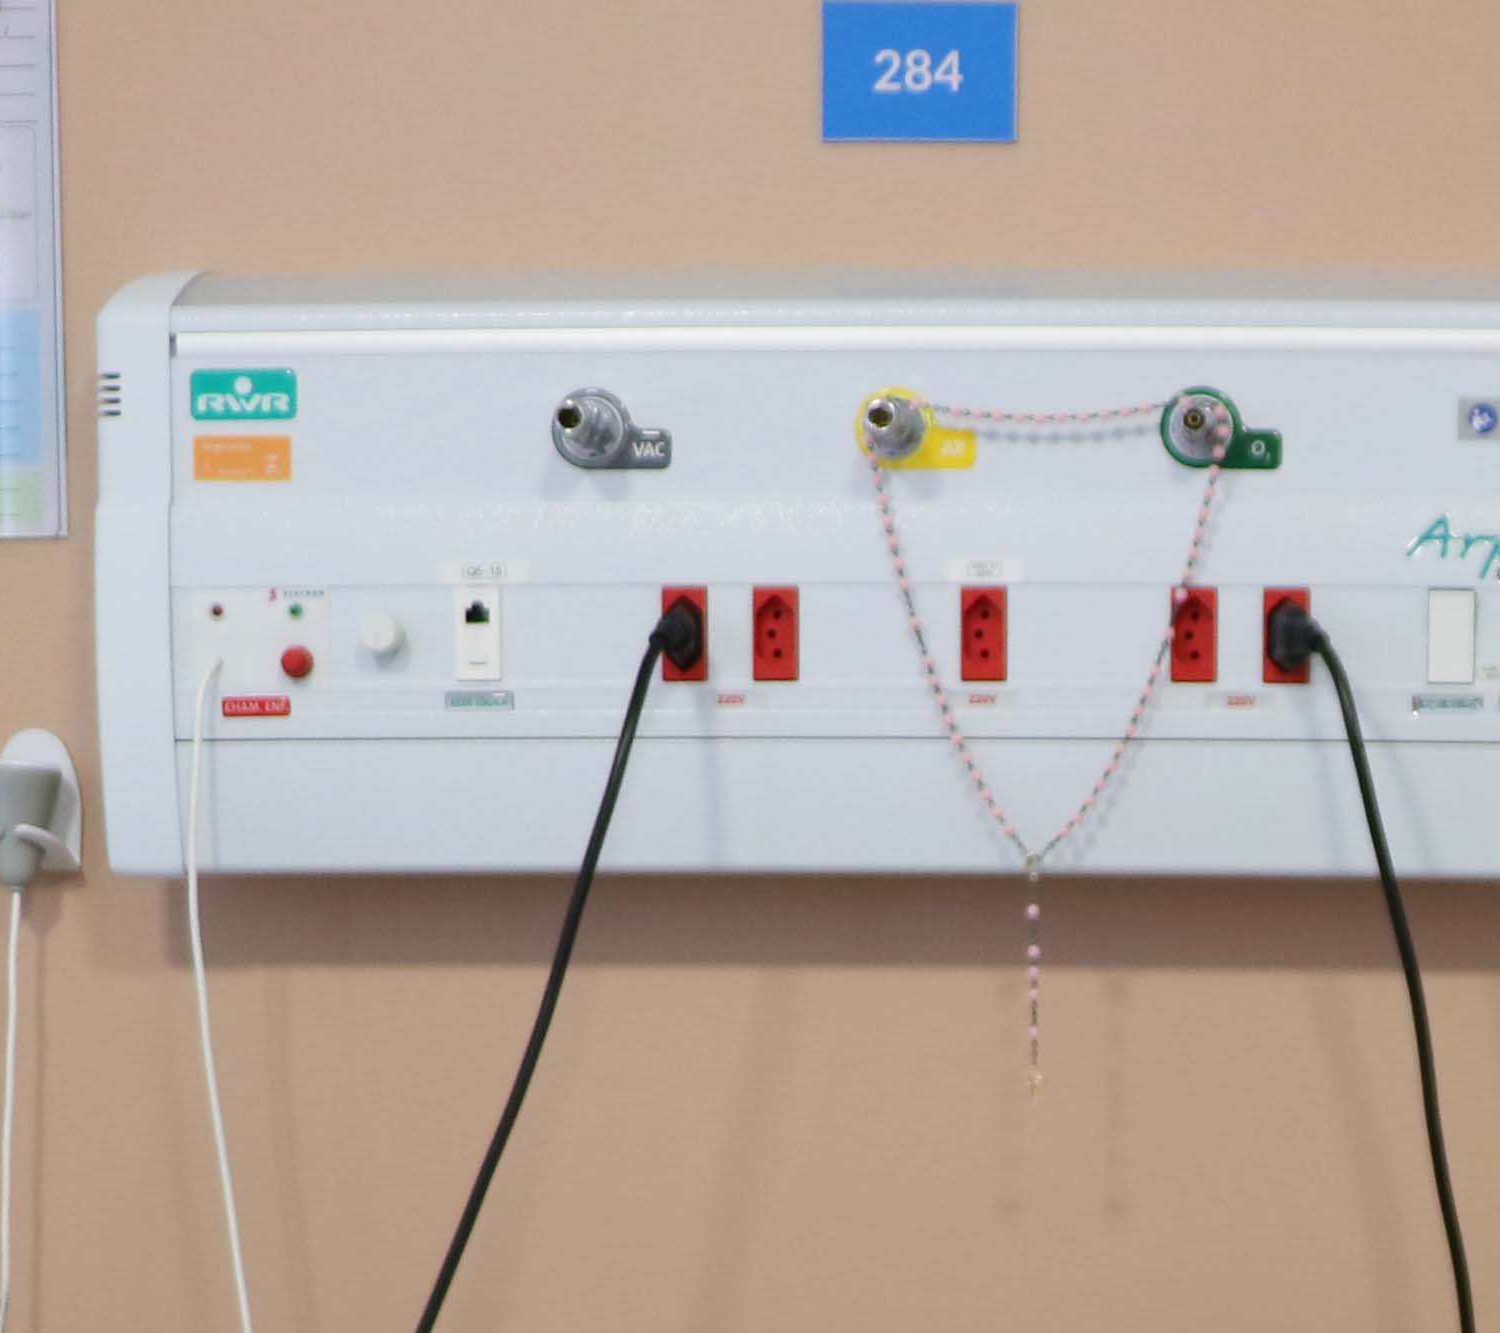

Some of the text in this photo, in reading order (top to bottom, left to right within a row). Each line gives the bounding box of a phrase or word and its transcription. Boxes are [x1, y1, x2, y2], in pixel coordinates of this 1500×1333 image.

[872, 48, 964, 93] 284
[196, 392, 292, 414] RWR
[632, 440, 667, 458] VAC
